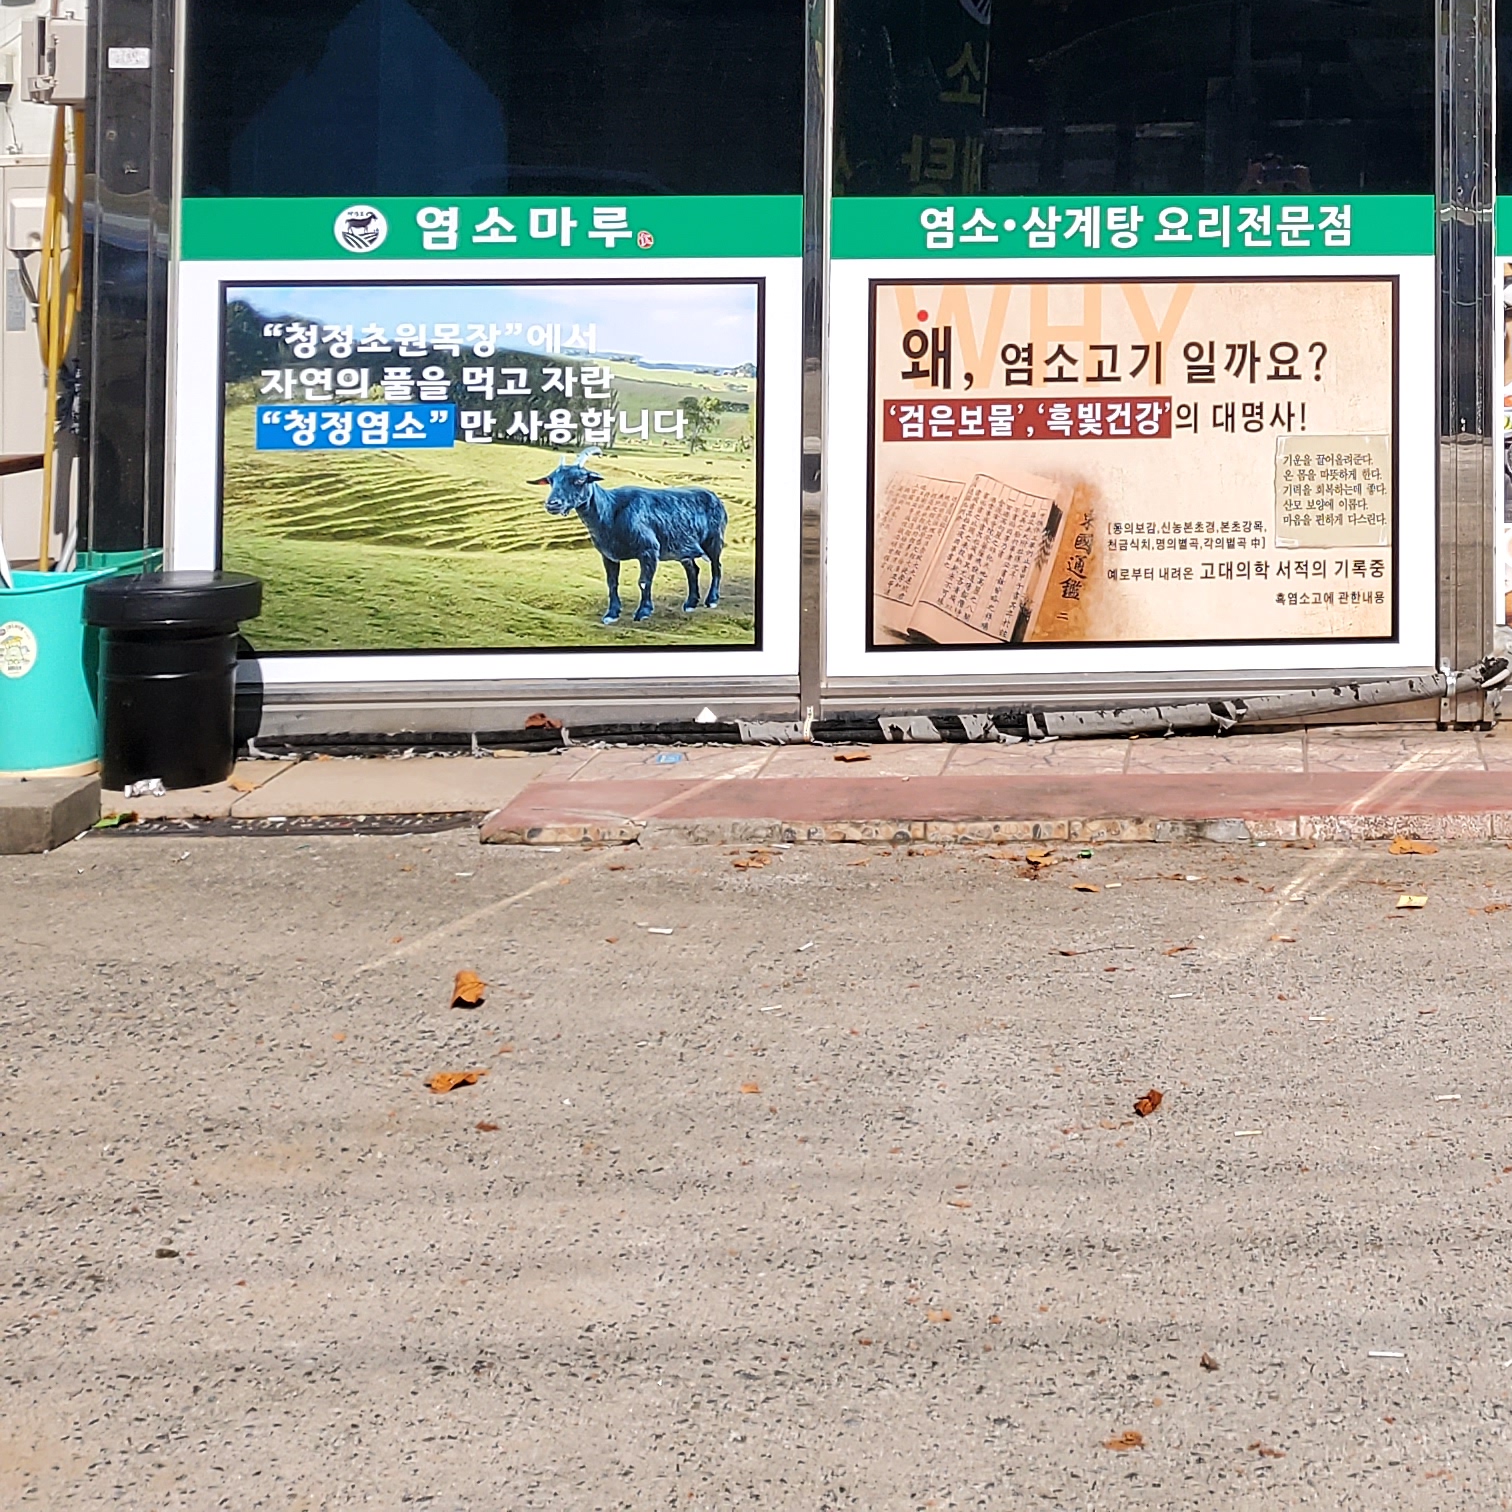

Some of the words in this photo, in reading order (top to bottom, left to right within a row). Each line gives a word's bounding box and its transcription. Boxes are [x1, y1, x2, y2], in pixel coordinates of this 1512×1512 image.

[416, 206, 633, 251] 염소마루
[920, 206, 1144, 250] 염소·삼계탕
[1153, 204, 1353, 249] 요리전문점
[900, 324, 975, 391] 왜,
[1000, 340, 1163, 386] 염소고기
[1182, 340, 1328, 385] 일까요?
[260, 366, 369, 400] 자연의
[382, 367, 451, 402] 풀을
[461, 365, 531, 399] 먹고
[541, 365, 615, 399] 자란
[460, 409, 493, 443] 만
[506, 407, 689, 443] 사용합니다
[1212, 400, 1308, 435] 대명사!
[1283, 454, 1312, 466] 기운을
[1283, 470, 1294, 481] 온
[1320, 468, 1357, 481] 따뜻하게
[1315, 483, 1362, 496] 회복하는데
[1283, 498, 1303, 511] 산모
[1306, 498, 1334, 511] 보양에
[1283, 514, 1312, 527] 마음을
[1107, 568, 1154, 581] 예로부터
[1159, 567, 1194, 581] 내려온
[1200, 560, 1270, 580] 고대의학
[1276, 559, 1327, 579] 서적의
[1334, 559, 1385, 579] 기록중
